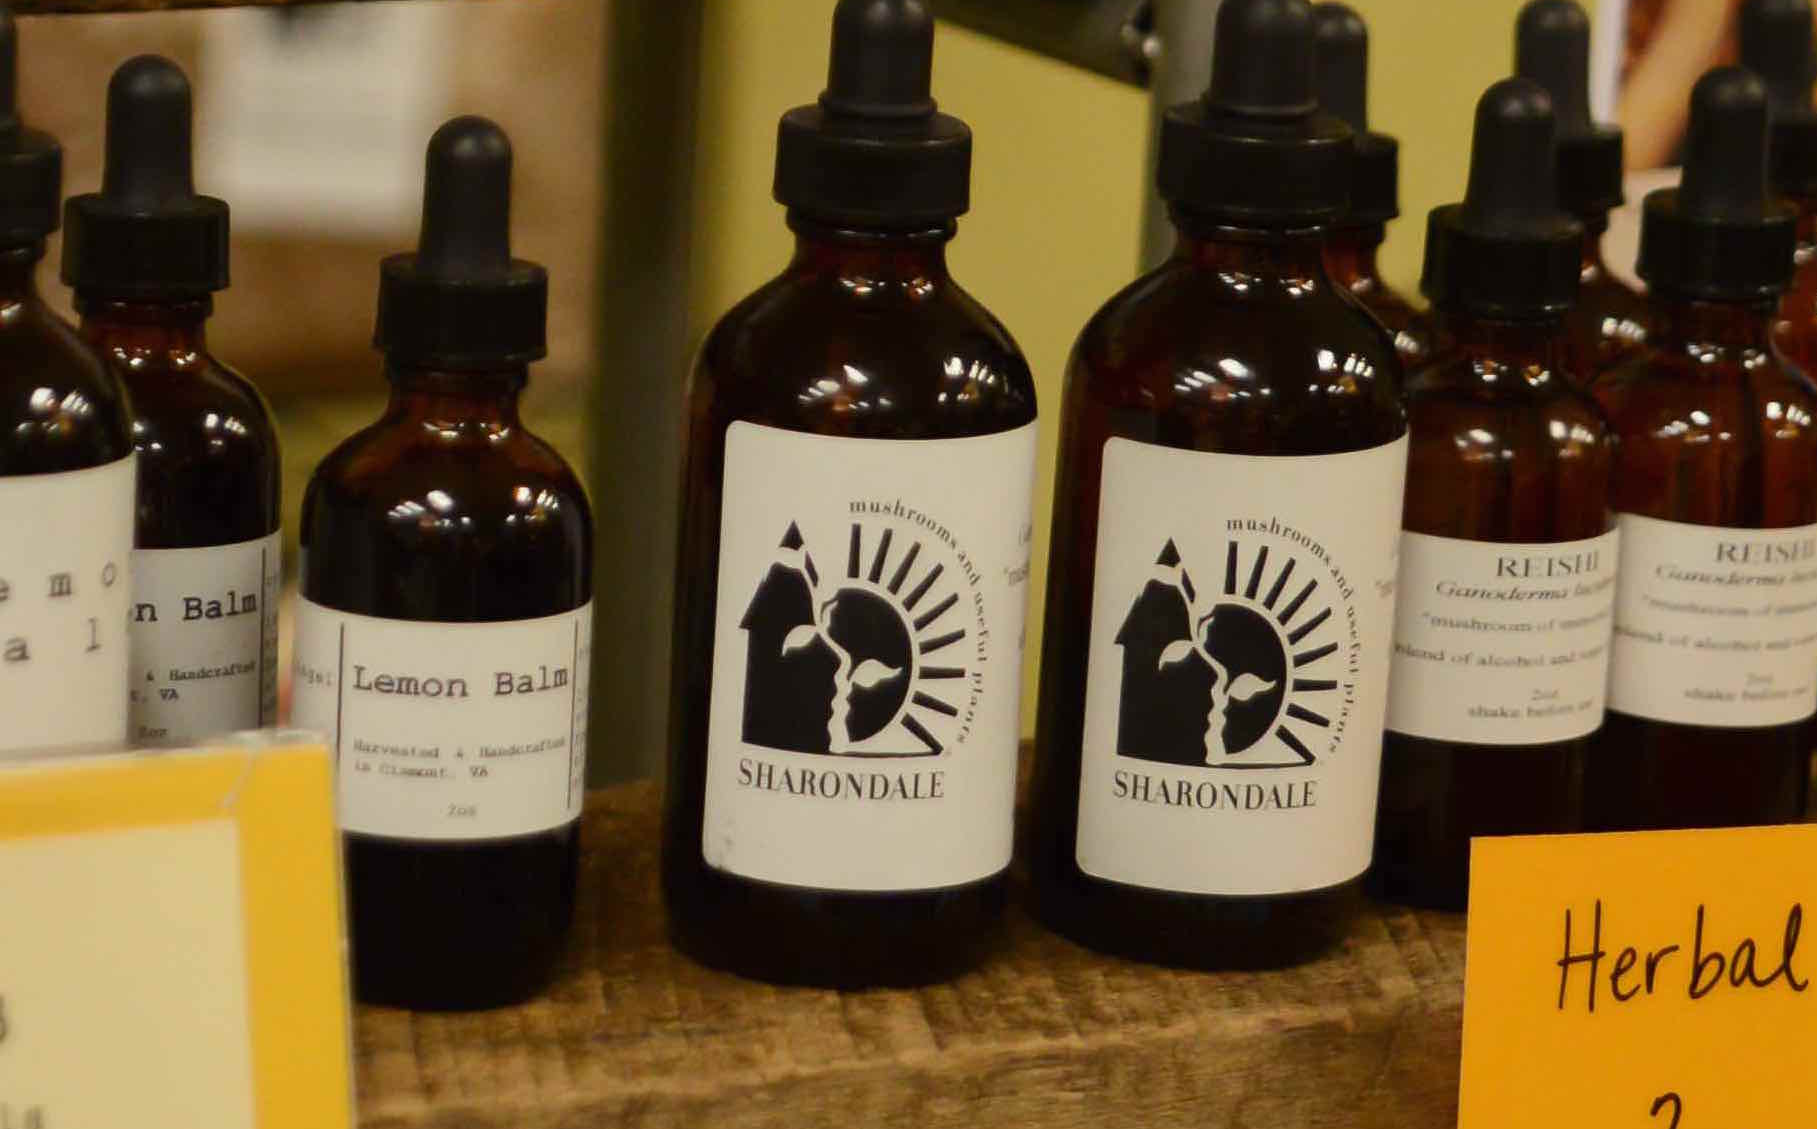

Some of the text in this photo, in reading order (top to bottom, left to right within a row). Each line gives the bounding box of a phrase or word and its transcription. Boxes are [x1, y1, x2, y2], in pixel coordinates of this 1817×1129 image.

[849, 497, 958, 550] mushrooms
[957, 551, 981, 587] and
[1226, 516, 1332, 567] mushrooms
[1330, 568, 1354, 601] and
[1495, 549, 1601, 579] REISHI
[181, 590, 257, 622] Balm
[1434, 578, 1568, 603] Ganoderma
[1477, 649, 1545, 669] alcohol
[353, 664, 569, 698] Lemon Balm
[738, 757, 946, 800] SHARONDALE
[1112, 769, 1318, 811] SHARONDALE
[1555, 896, 1811, 1014] Herbal
